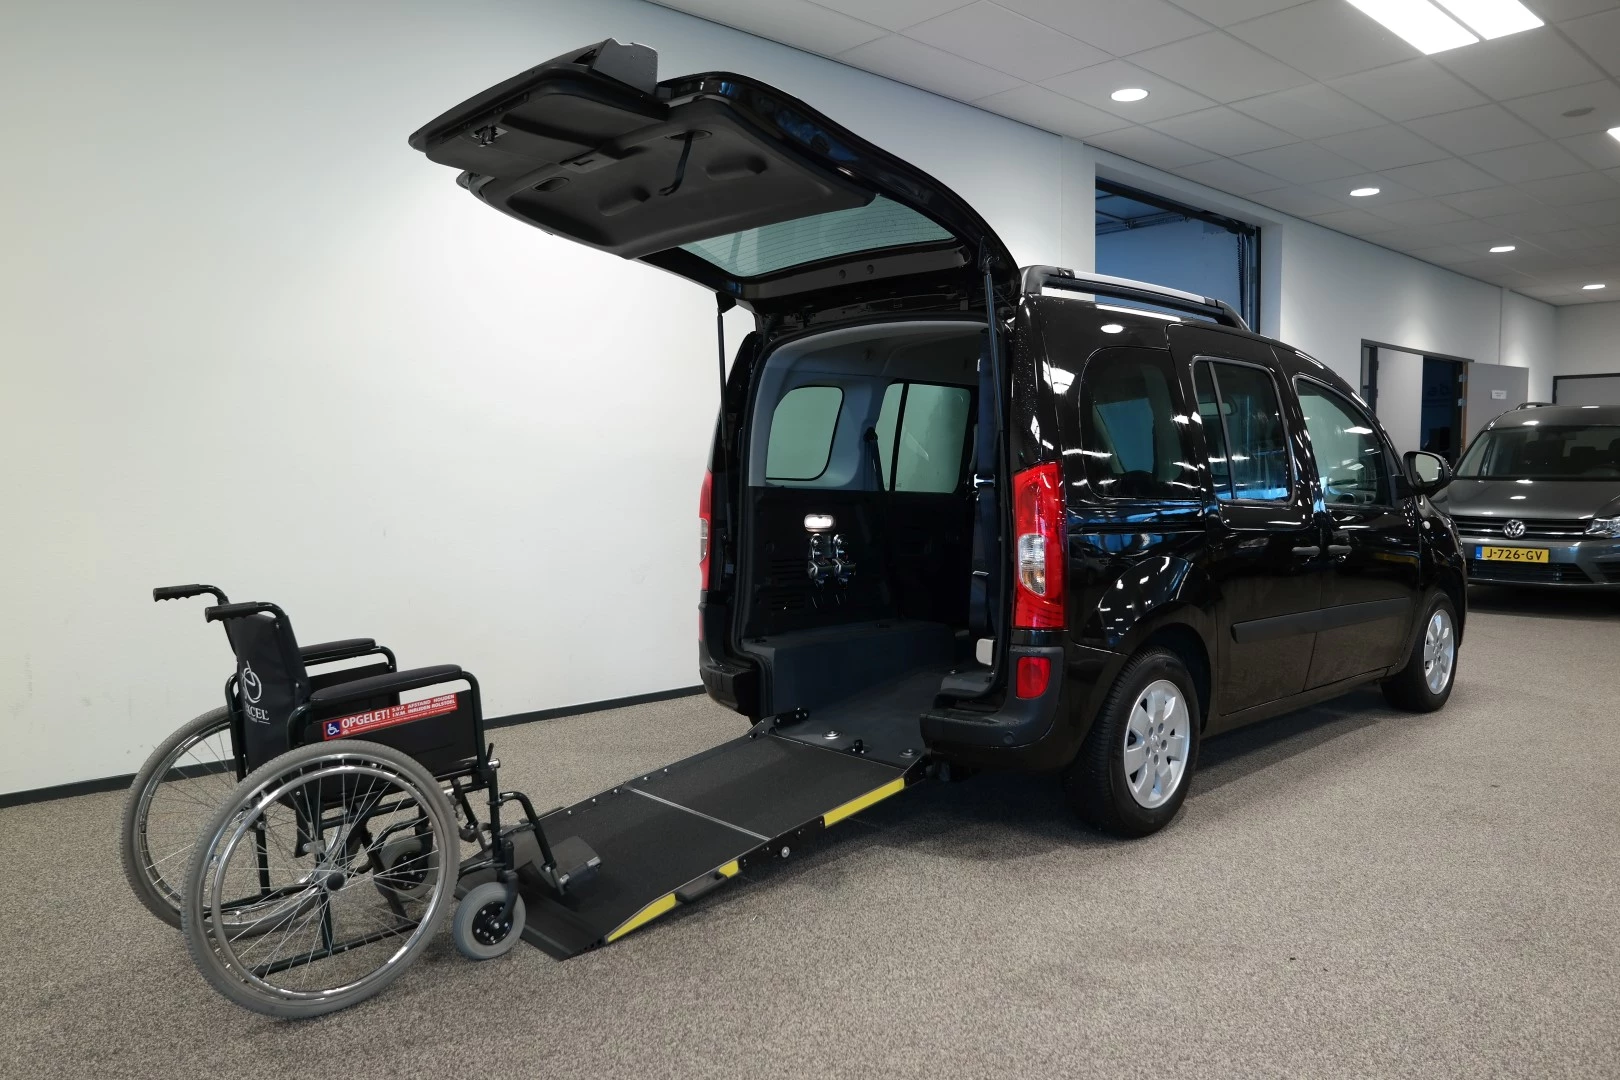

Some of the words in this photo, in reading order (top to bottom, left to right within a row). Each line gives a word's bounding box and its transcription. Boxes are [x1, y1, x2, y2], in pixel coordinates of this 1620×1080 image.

[1486, 548, 1543, 560] J-726-GV
[407, 699, 432, 709] AFSTAND
[433, 694, 455, 703] HOUDEN
[341, 708, 390, 729] OPGELET!
